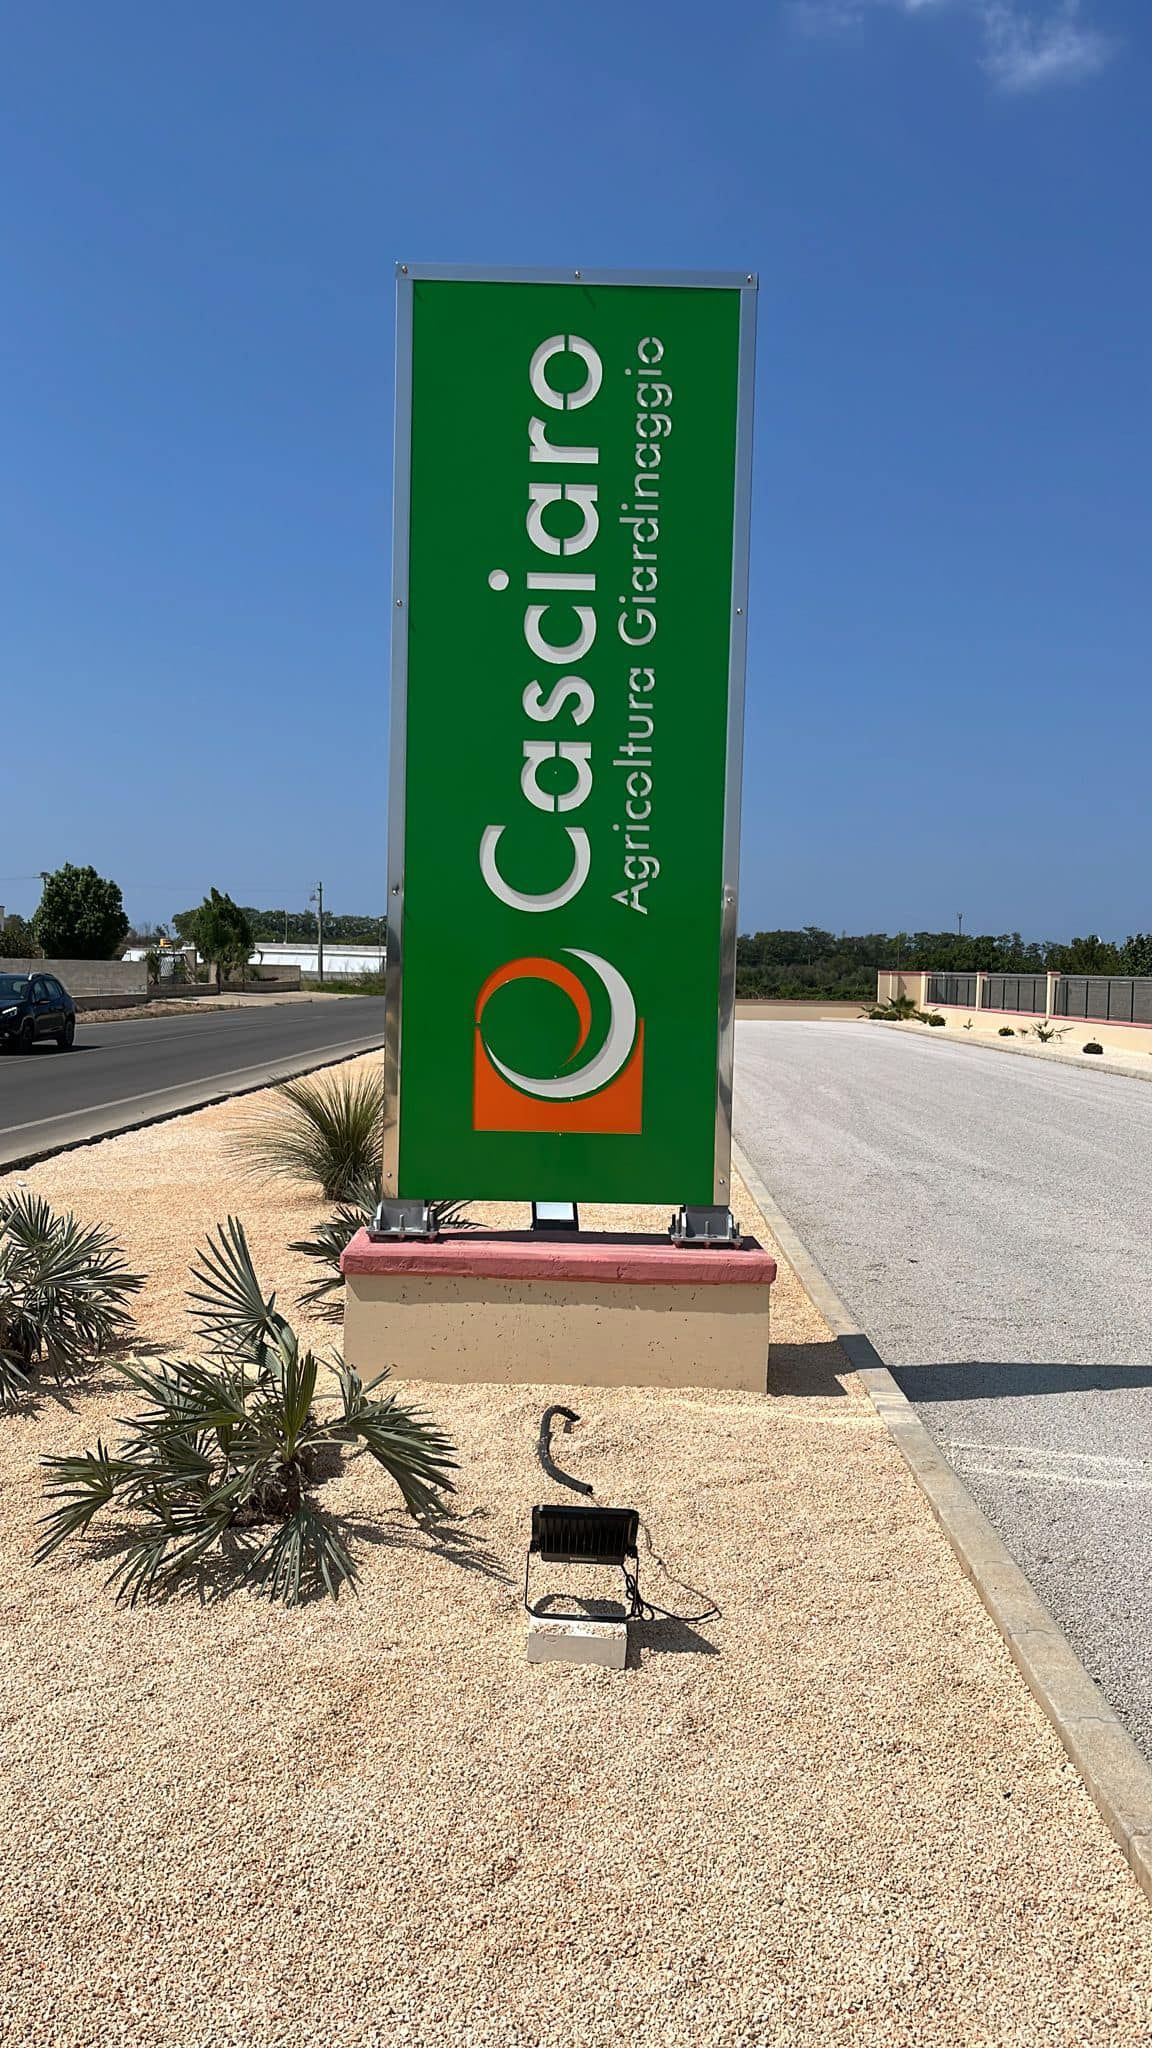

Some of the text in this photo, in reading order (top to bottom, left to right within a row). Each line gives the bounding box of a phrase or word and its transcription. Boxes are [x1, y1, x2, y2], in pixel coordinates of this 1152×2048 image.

[479, 334, 603, 913] Casciaro
[611, 336, 673, 915] Agricoltura Giardinaggio
